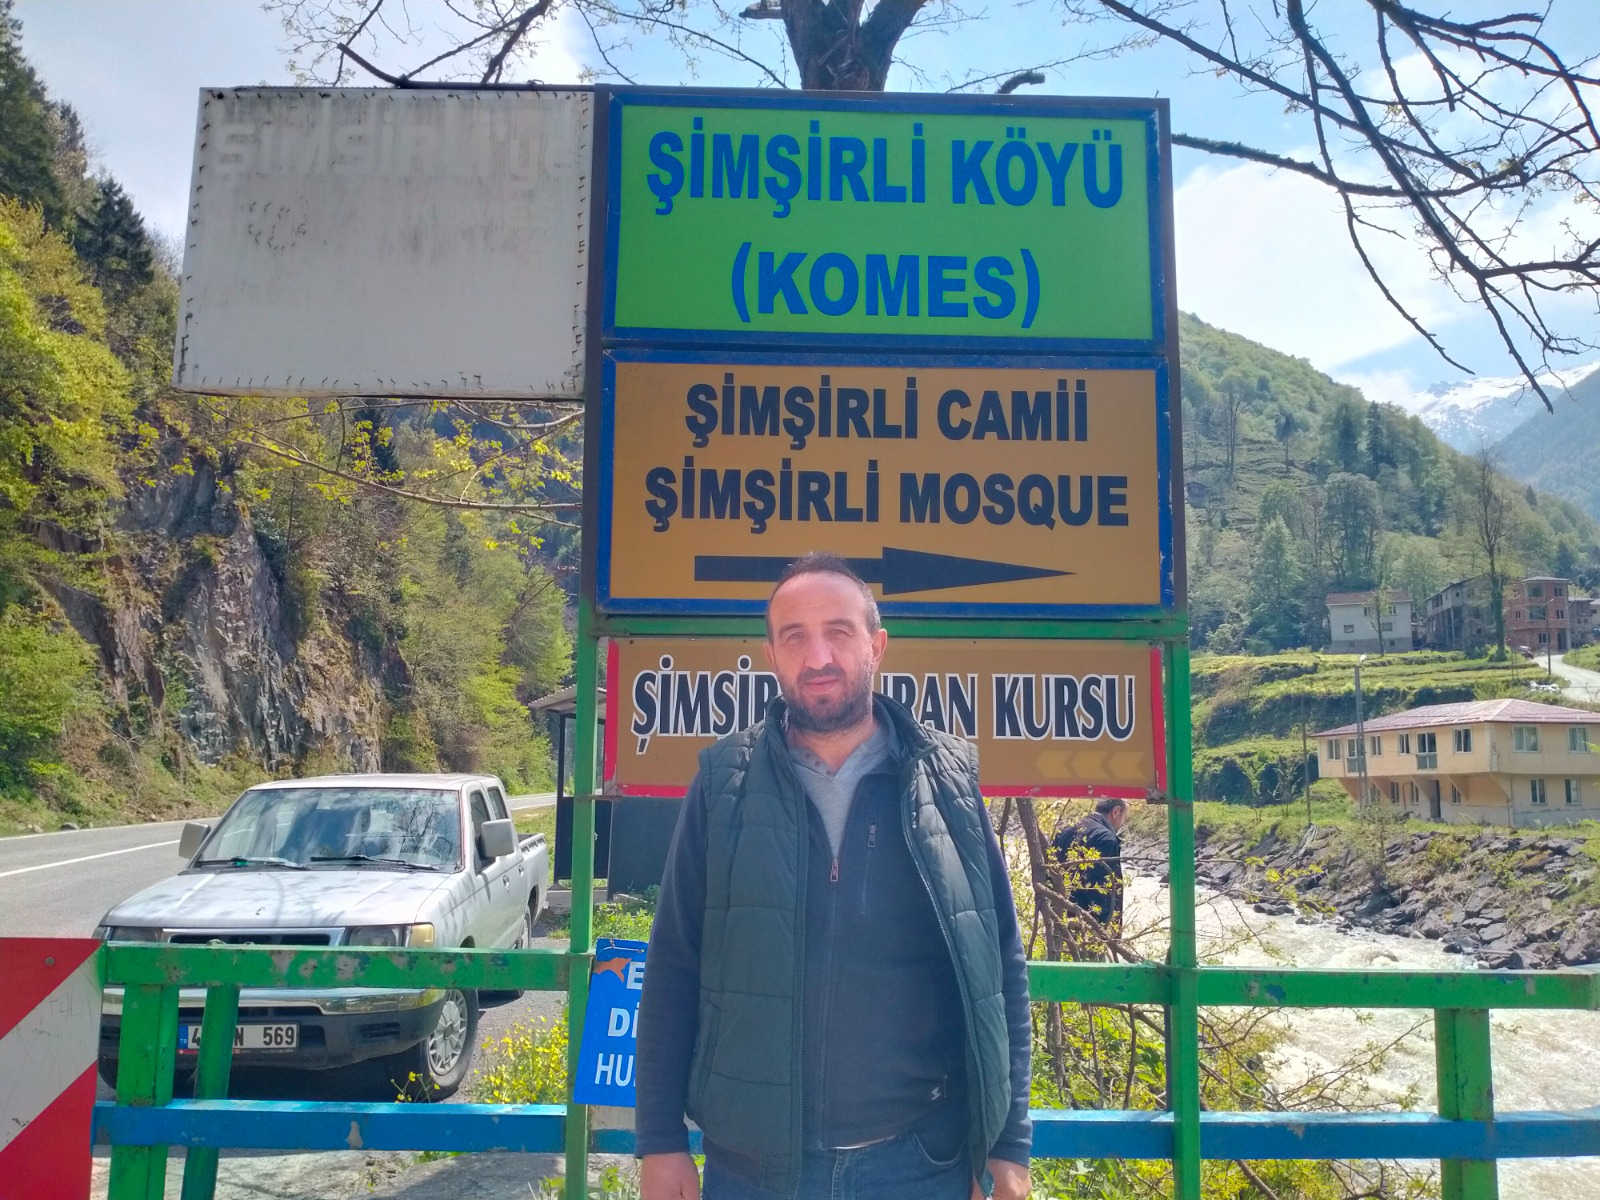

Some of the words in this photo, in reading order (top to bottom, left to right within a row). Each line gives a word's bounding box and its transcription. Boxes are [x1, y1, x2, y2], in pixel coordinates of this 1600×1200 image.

[647, 117, 926, 219] ŞİMŞİRLİ
[951, 126, 1124, 208] KÖYÜ
[731, 242, 1041, 329] (KOMES)
[685, 372, 918, 450] ŞİMŞİRLİ
[936, 379, 1089, 442] CAMİİ
[644, 456, 880, 534] ŞİMŞİRLİ
[900, 473, 1130, 531] MOSQUE
[992, 673, 1136, 742] KURSU
[263, 1026, 295, 1047] 569
